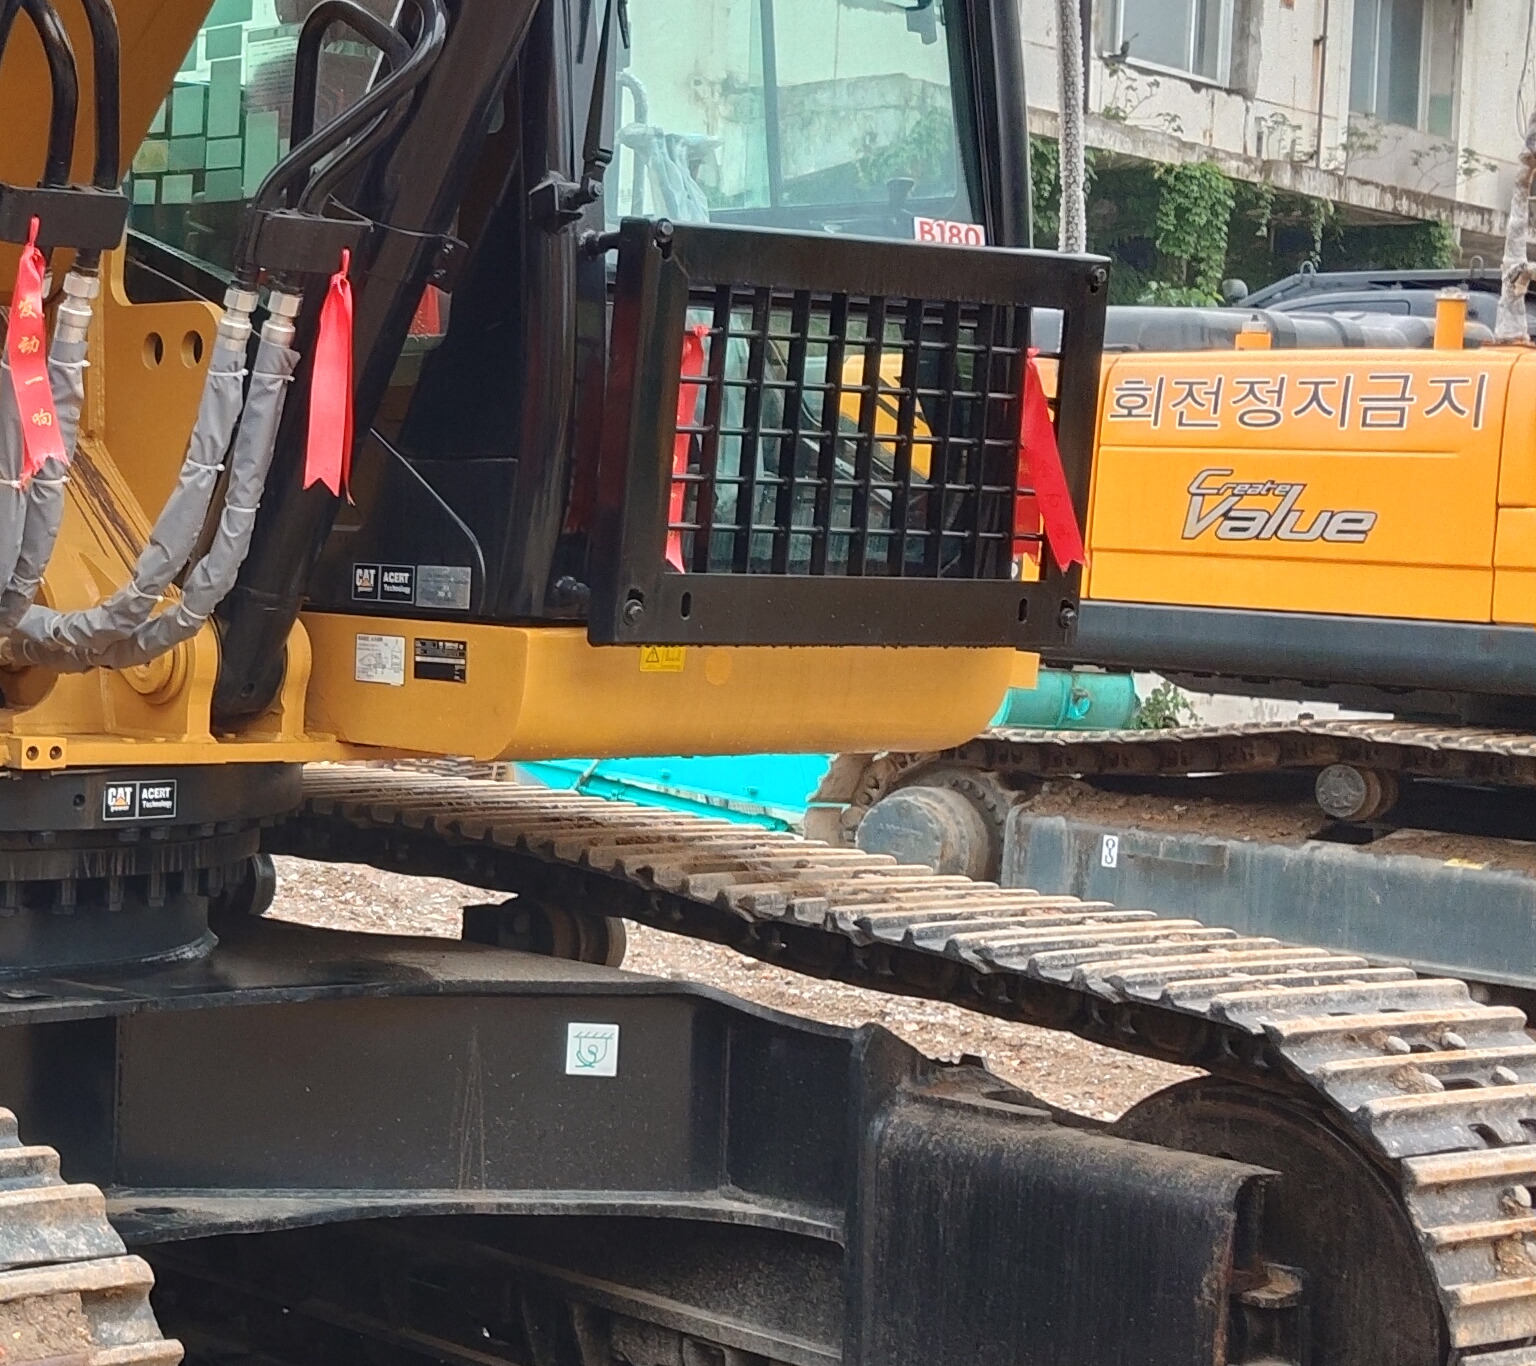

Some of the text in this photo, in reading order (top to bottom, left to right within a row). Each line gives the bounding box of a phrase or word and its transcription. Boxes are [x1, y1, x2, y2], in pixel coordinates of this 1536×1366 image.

[919, 220, 981, 247] B180
[1108, 372, 1489, 431] 회전정지금지
[1188, 468, 1292, 496] Create
[1181, 483, 1378, 543] Value
[355, 568, 376, 587] CAT
[383, 571, 410, 584] ACERT
[107, 787, 133, 807] CAT
[141, 787, 172, 800] ACERT
